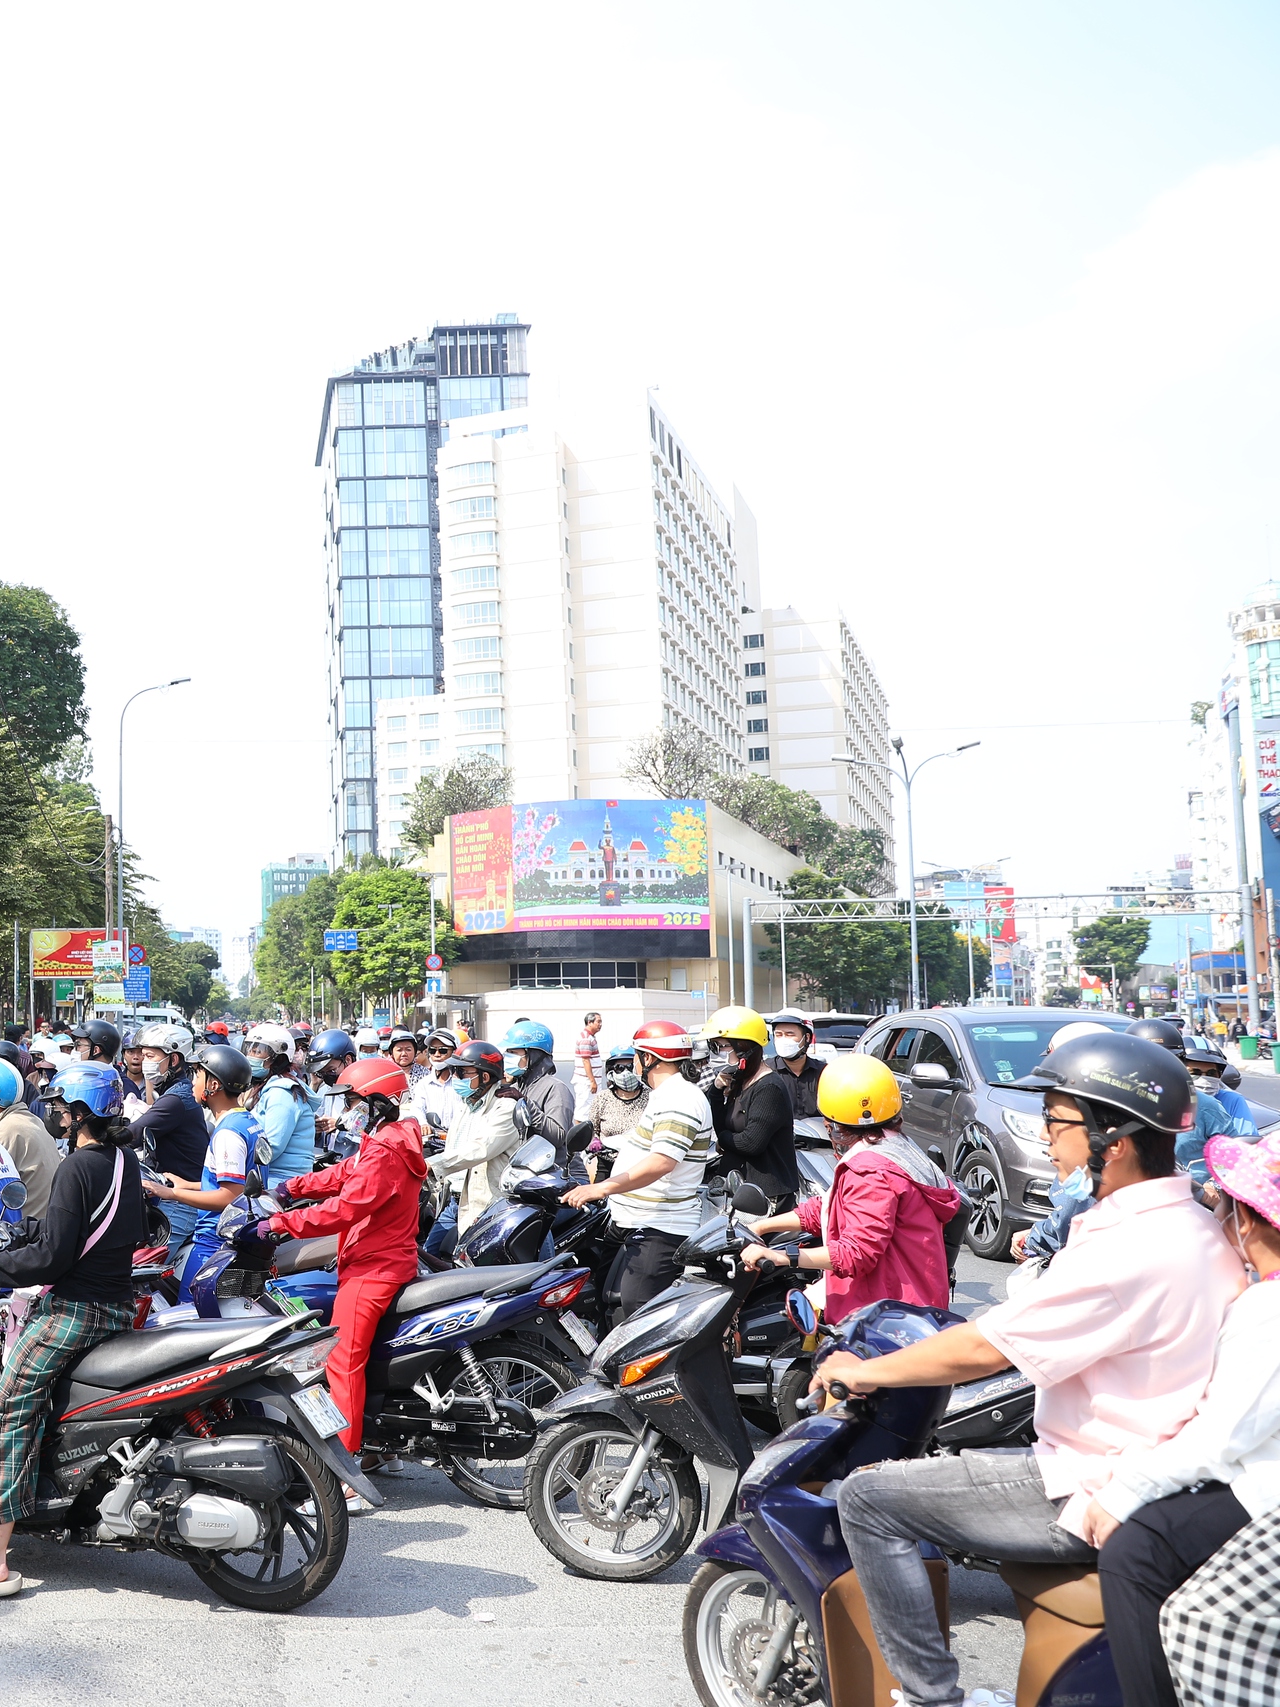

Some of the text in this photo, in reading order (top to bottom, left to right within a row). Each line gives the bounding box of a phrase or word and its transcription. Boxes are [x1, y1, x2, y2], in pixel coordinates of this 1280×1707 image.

[477, 832, 494, 842] MINH
[469, 843, 487, 854] HOAN
[455, 855, 472, 865] CHÀO
[463, 910, 507, 931] 2025
[663, 912, 702, 926] 2025
[226, 1359, 254, 1373] 125
[636, 1387, 674, 1402] HONDA
[313, 1409, 344, 1433] 5654
[58, 1441, 100, 1463] SUZUKI
[197, 1521, 230, 1530] SUZUKI
